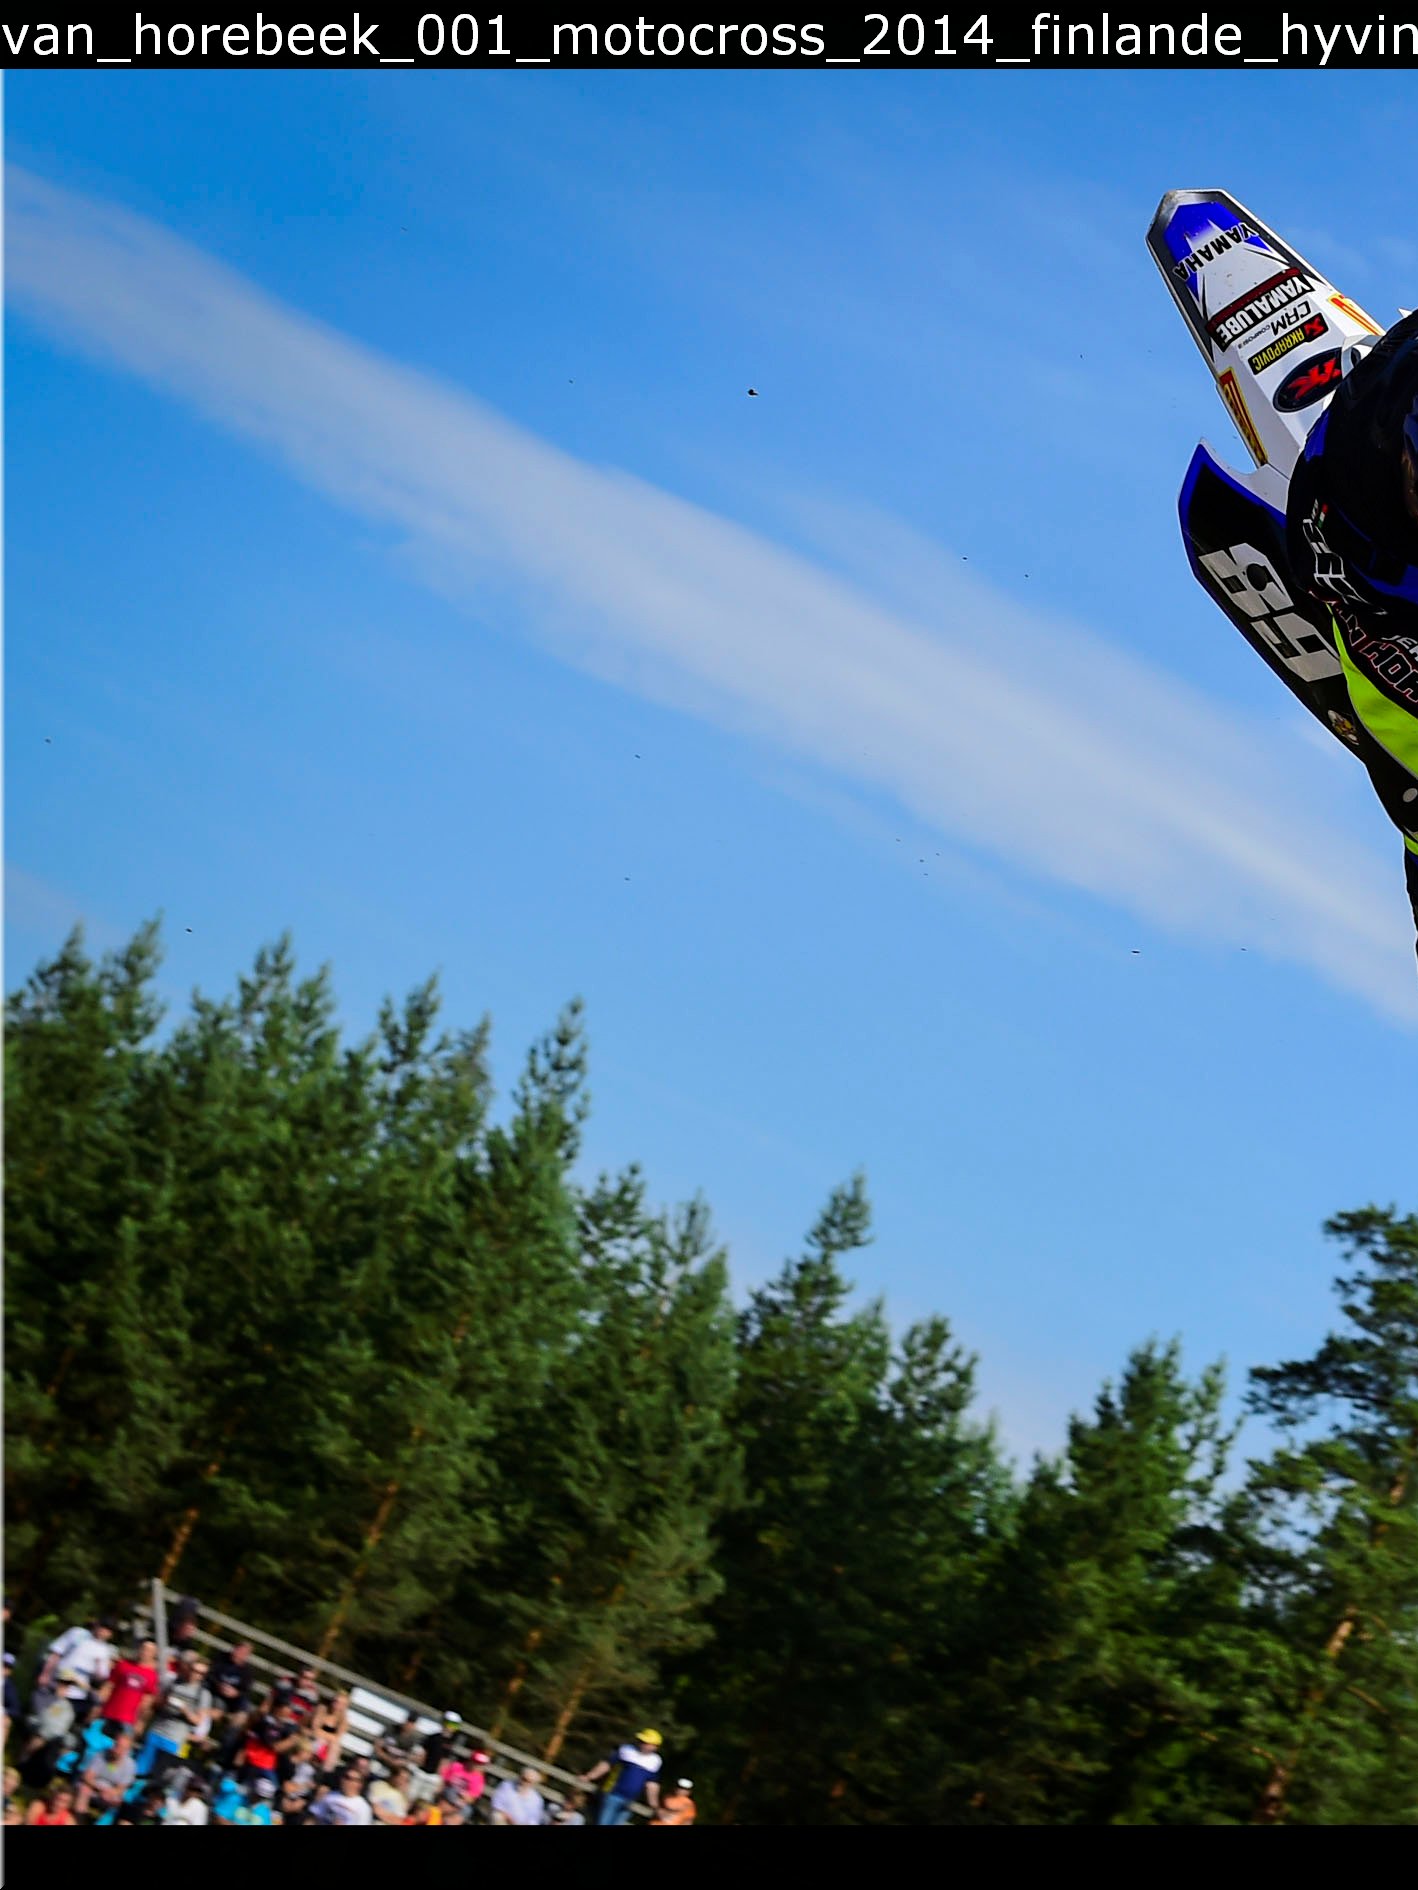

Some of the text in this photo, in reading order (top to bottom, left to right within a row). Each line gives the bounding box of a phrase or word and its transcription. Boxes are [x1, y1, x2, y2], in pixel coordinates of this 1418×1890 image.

[1172, 222, 1260, 282] YAMAHA
[1215, 275, 1313, 342] YAMALUBE
[1271, 300, 1312, 336] CRM
[1199, 543, 1344, 682] 89
